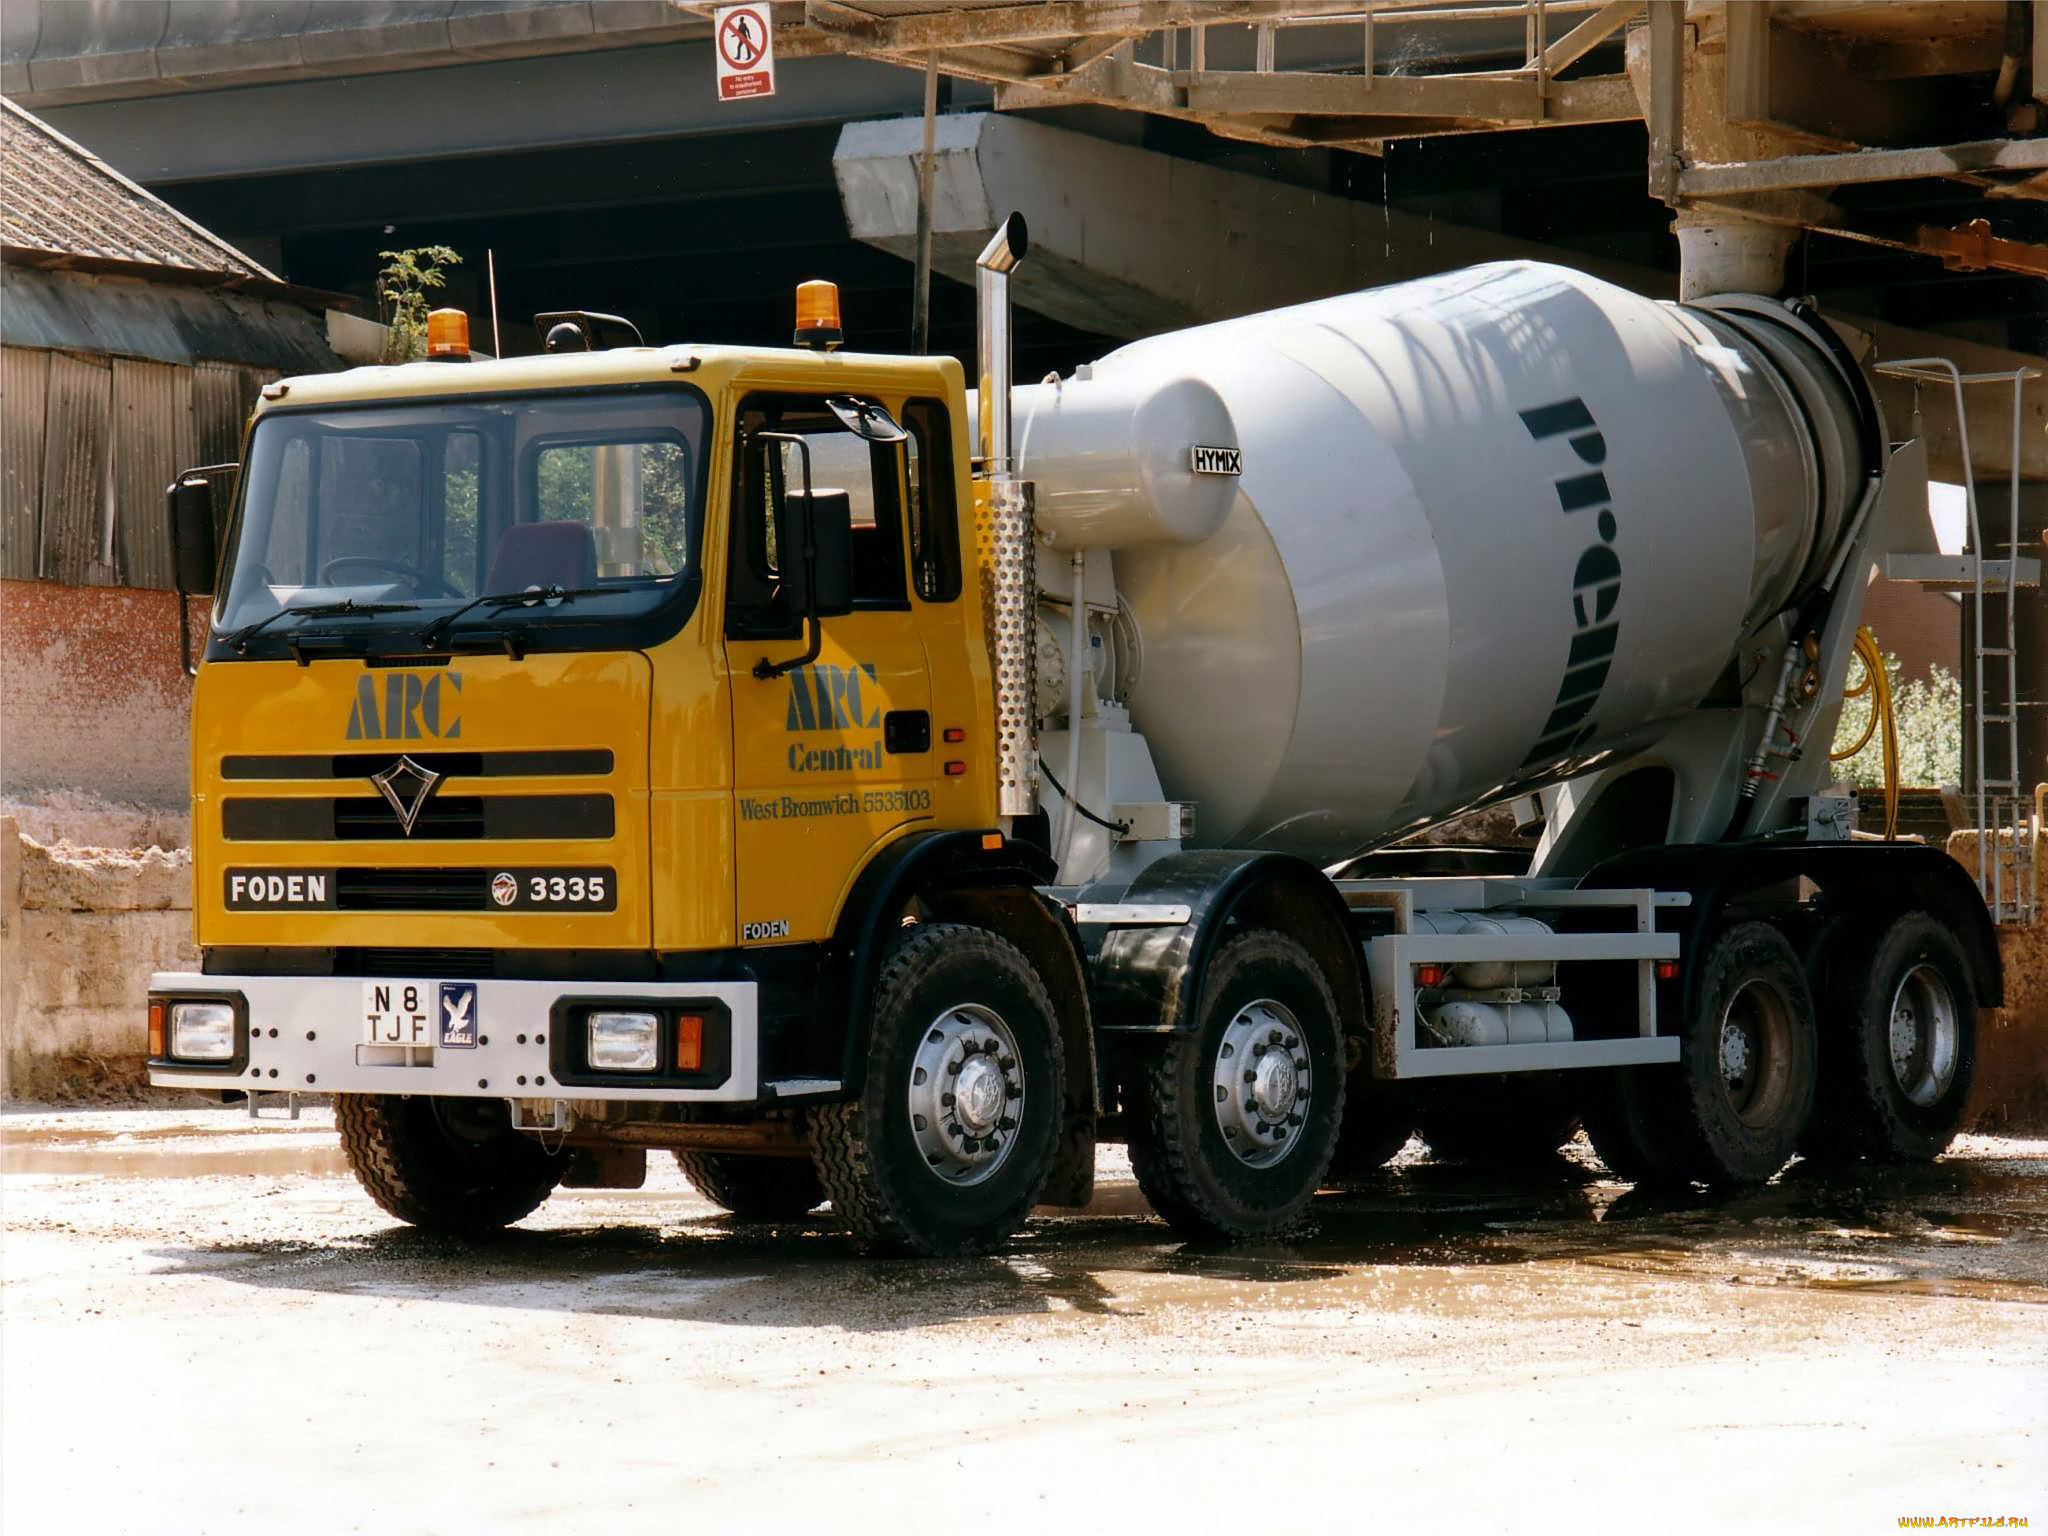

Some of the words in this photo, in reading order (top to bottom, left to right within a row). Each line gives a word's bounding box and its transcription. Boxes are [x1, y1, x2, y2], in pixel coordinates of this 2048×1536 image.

[1195, 449, 1241, 473] HYMIX
[344, 672, 463, 740] ARC
[786, 663, 881, 731] ARC
[787, 740, 882, 772] Central
[739, 798, 779, 821] West
[781, 793, 861, 819] Bromwich
[863, 789, 931, 814] 5535103
[231, 875, 326, 902] FODEN
[529, 876, 605, 902] 3335
[743, 919, 790, 940] FODEN
[375, 985, 390, 1012] N
[403, 985, 418, 1012] 8
